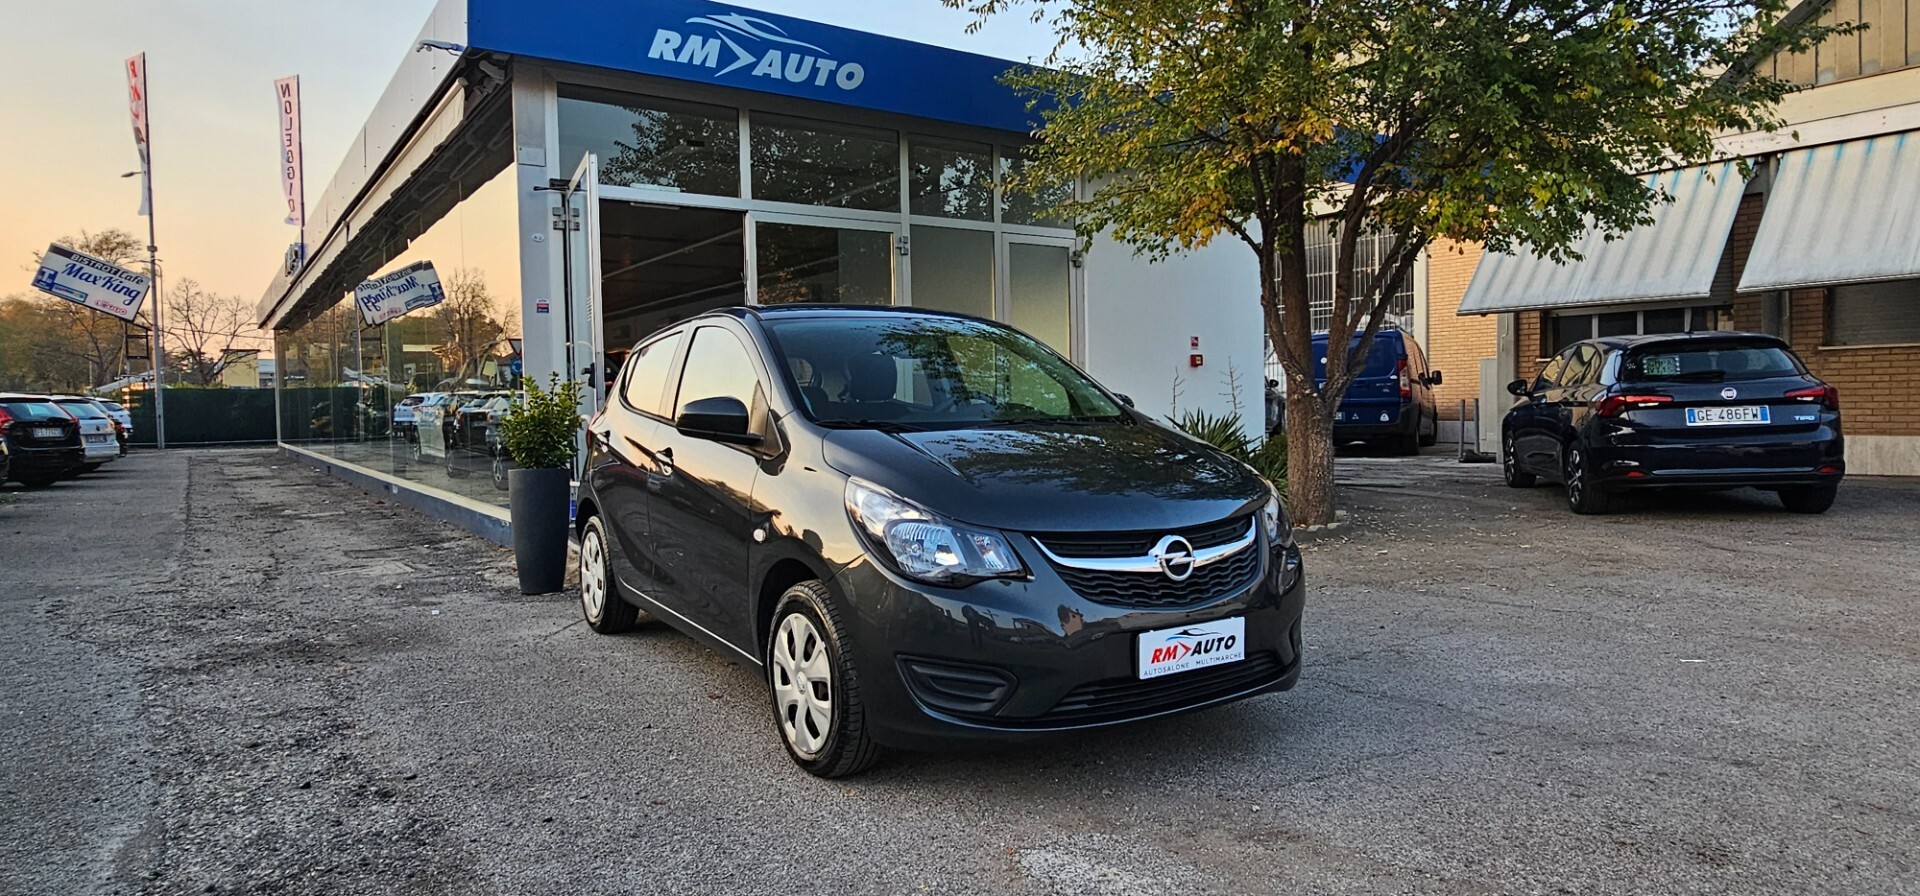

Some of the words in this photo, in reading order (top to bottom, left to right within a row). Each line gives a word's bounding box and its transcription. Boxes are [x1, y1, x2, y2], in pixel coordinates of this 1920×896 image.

[751, 49, 865, 91] AUTO
[71, 253, 120, 276] BISTROT
[1696, 409, 1713, 421] GE
[1718, 408, 1759, 420] 486FW
[1190, 634, 1236, 657] AUTO
[1143, 662, 1190, 676] AUTOSALONE
[1195, 652, 1242, 666] MULTIMARCHE
